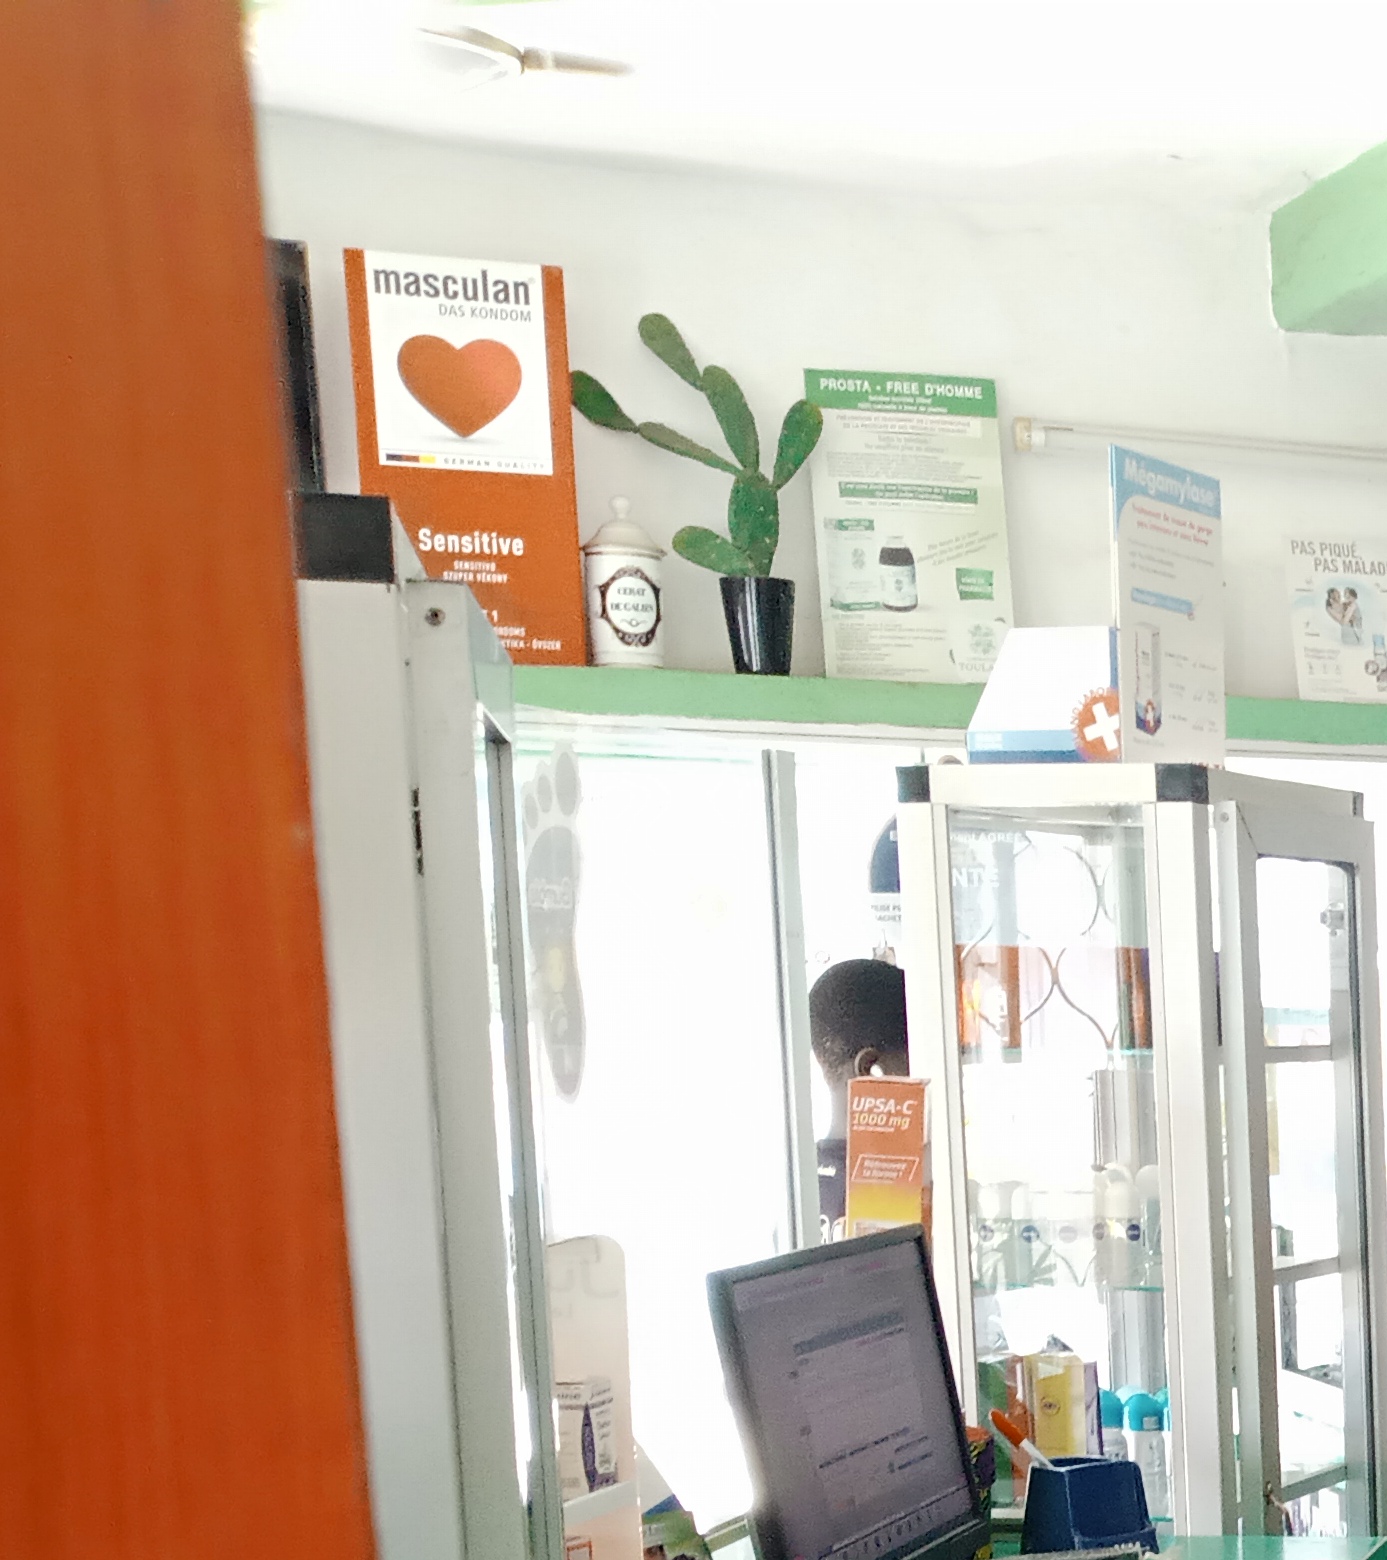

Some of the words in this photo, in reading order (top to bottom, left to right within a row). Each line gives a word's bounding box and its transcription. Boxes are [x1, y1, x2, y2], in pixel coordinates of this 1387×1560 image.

[373, 268, 531, 306] masculan
[439, 303, 465, 318] DAS
[470, 306, 532, 322] KONDOM
[820, 378, 872, 392] PROSTA
[887, 380, 920, 395] FREE
[925, 382, 983, 399] D'HOMME
[444, 458, 490, 467] GERMAN
[418, 528, 524, 556] Sensitive
[1291, 540, 1316, 556] PAS
[1314, 557, 1338, 573] PAS
[852, 1096, 914, 1114] UPSA-C
[852, 1112, 887, 1127] 1000
[889, 1115, 909, 1130] mg
